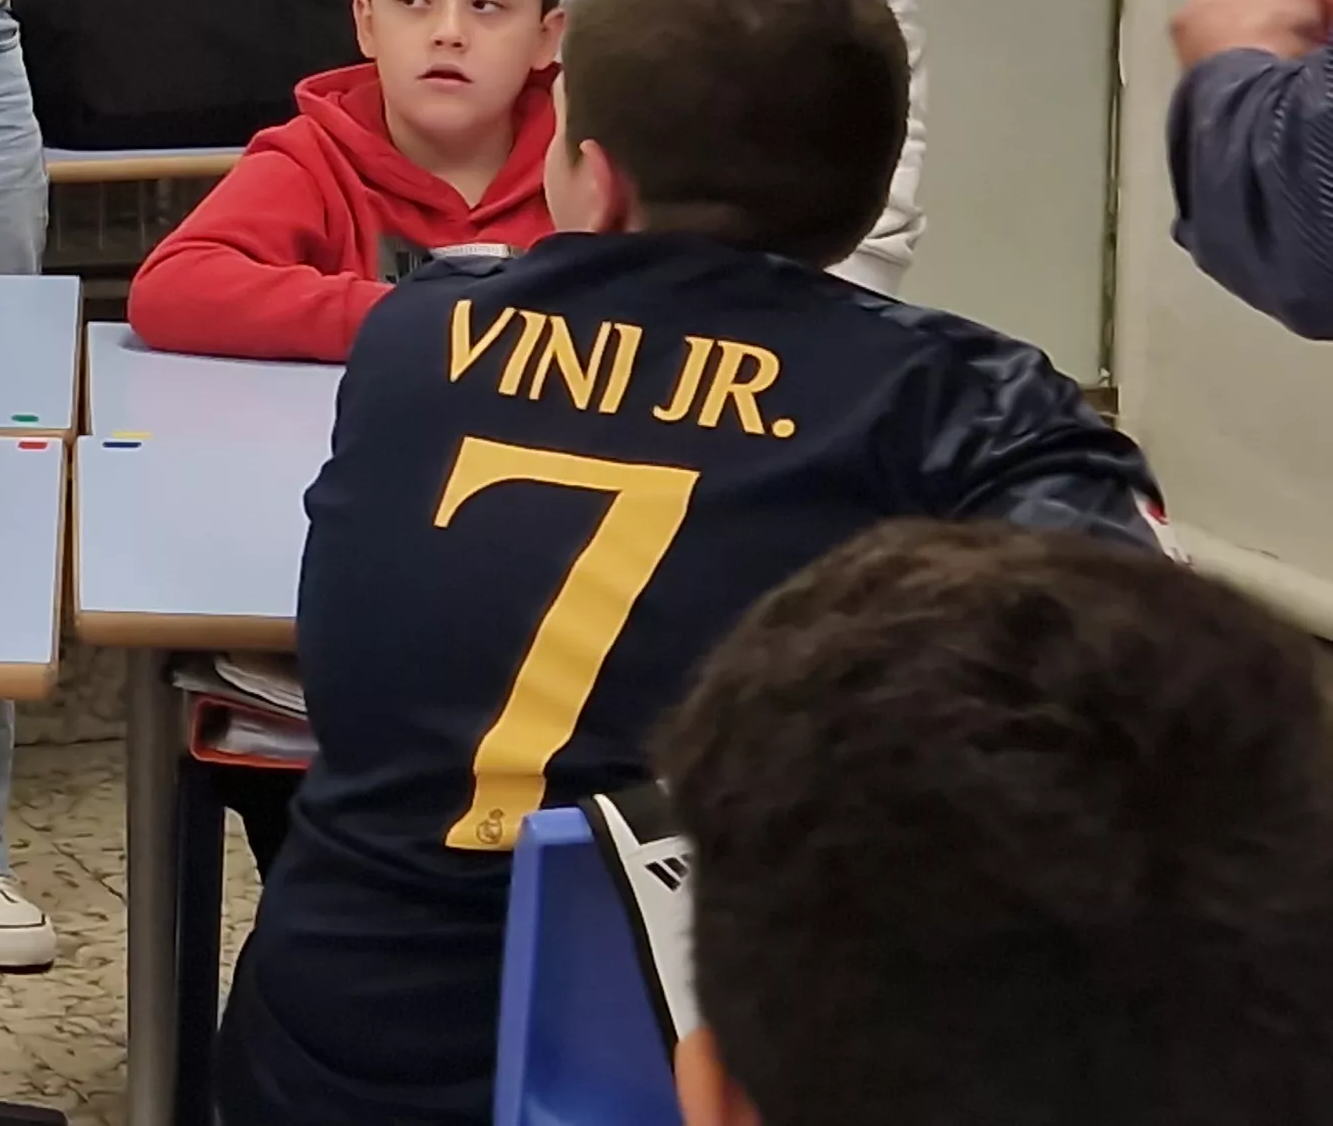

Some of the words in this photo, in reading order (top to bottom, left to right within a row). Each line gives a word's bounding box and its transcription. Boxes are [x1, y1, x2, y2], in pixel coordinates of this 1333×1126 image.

[449, 298, 643, 415] VINI
[651, 335, 797, 438] JR.
[433, 435, 701, 852] 7
